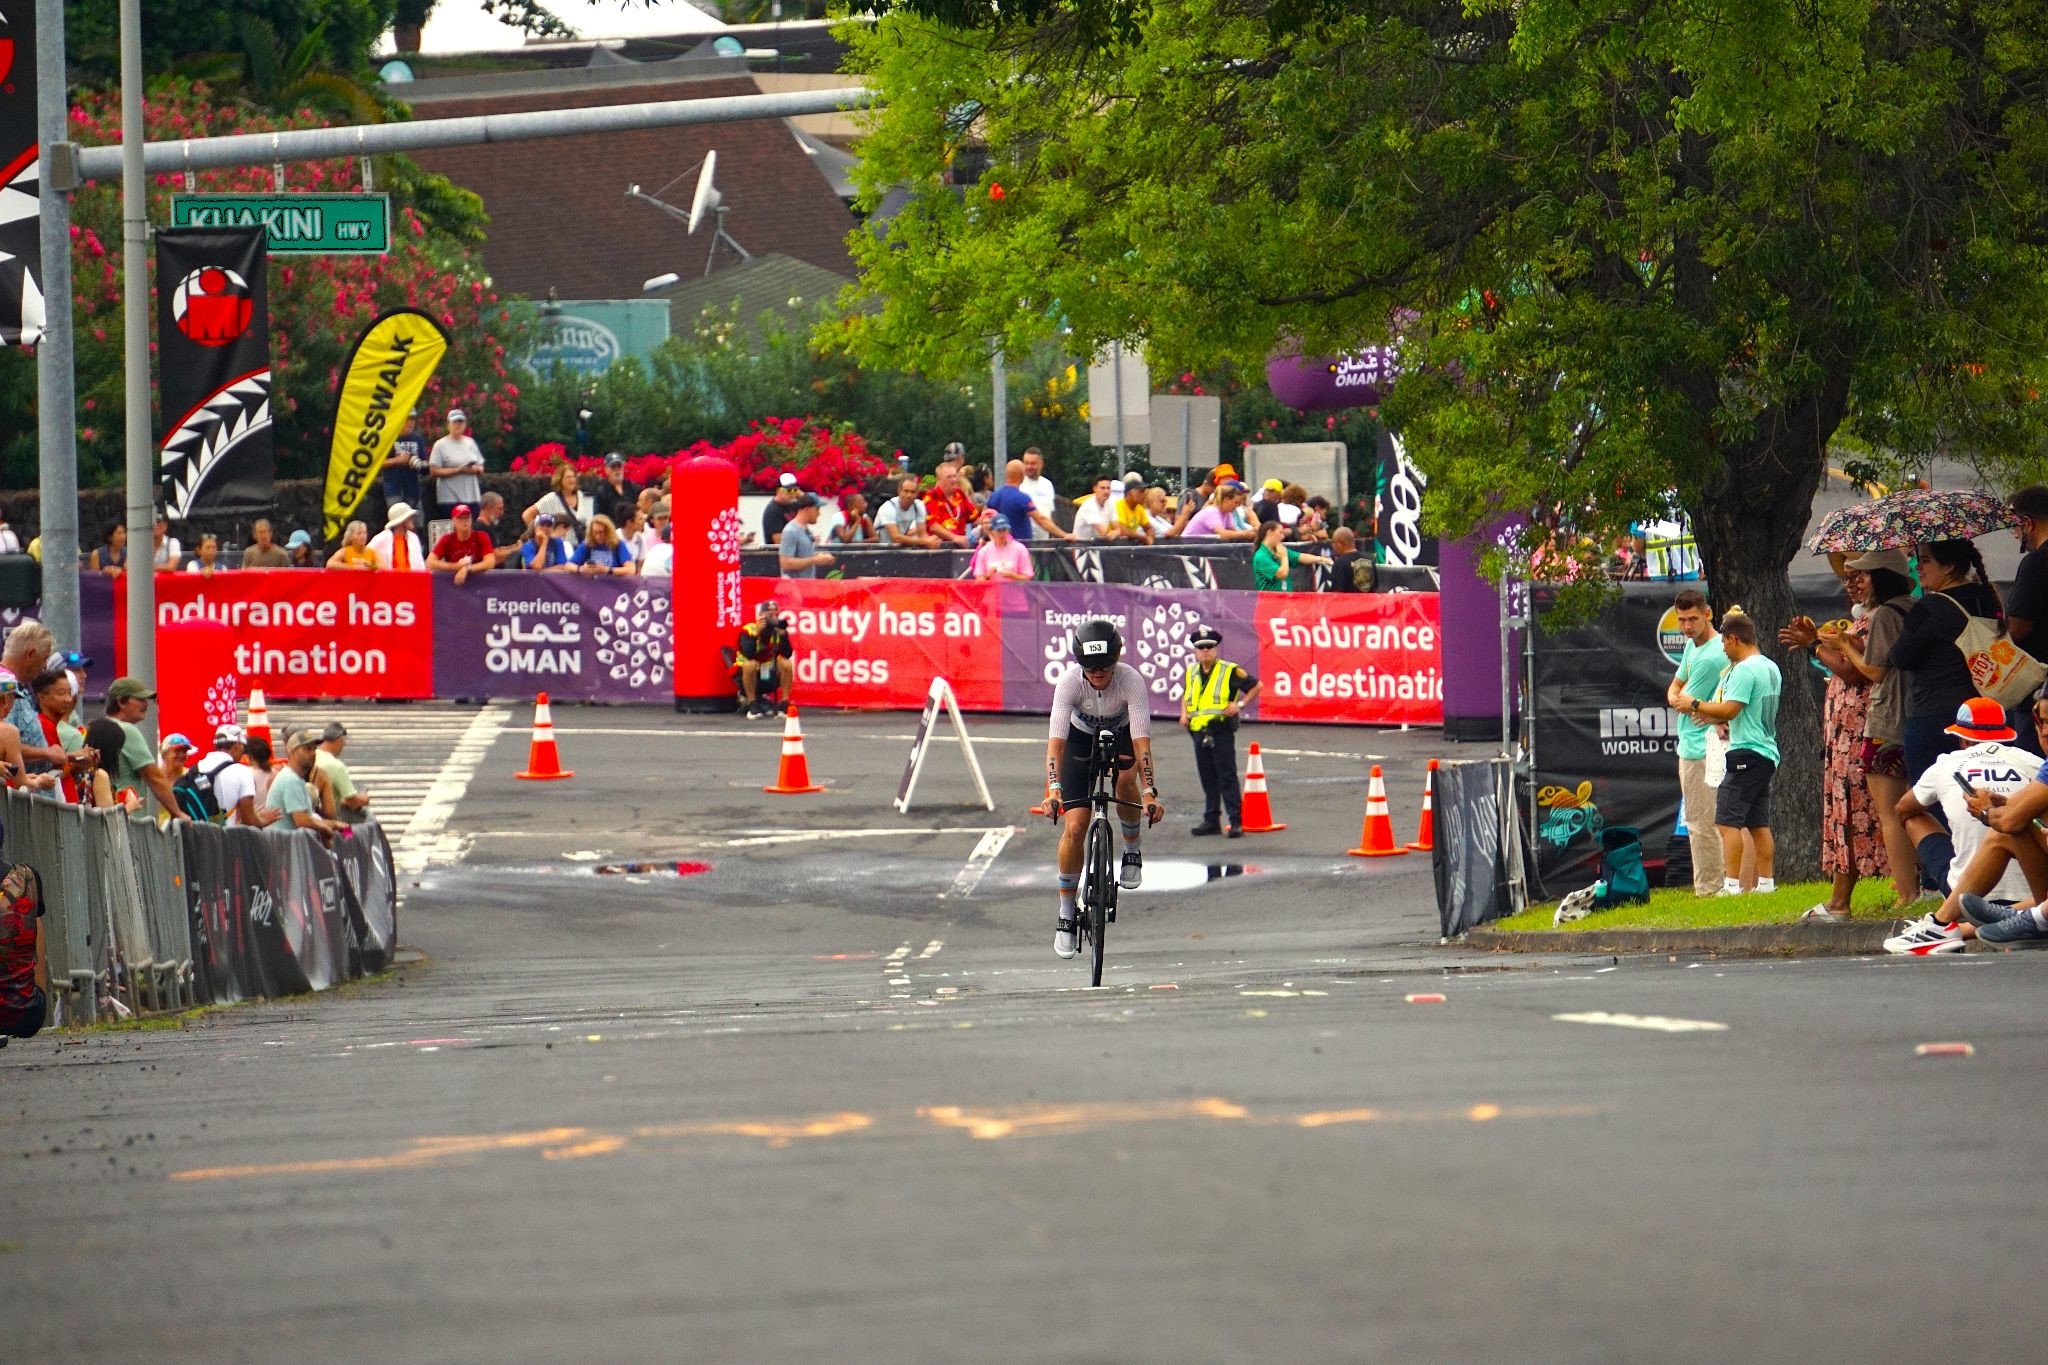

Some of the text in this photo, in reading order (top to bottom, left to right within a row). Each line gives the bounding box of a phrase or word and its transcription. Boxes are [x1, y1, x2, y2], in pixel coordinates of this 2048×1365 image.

[337, 221, 370, 239] HWY
[1335, 371, 1377, 387] OMAN
[337, 332, 414, 508] CROSSWALK
[157, 592, 416, 627] ndurance has
[486, 597, 581, 616] Experience
[779, 602, 982, 643] eauty has an
[1088, 643, 1102, 652] 153
[1269, 616, 1435, 651] Endurance
[233, 641, 388, 675] tination
[485, 648, 581, 675] OMAN
[791, 649, 889, 684] dress
[1971, 651, 1991, 687] SHOP
[1274, 663, 1444, 700] a destinati
[1601, 739, 1660, 756] WORLD
[1967, 768, 2022, 782] FILA
